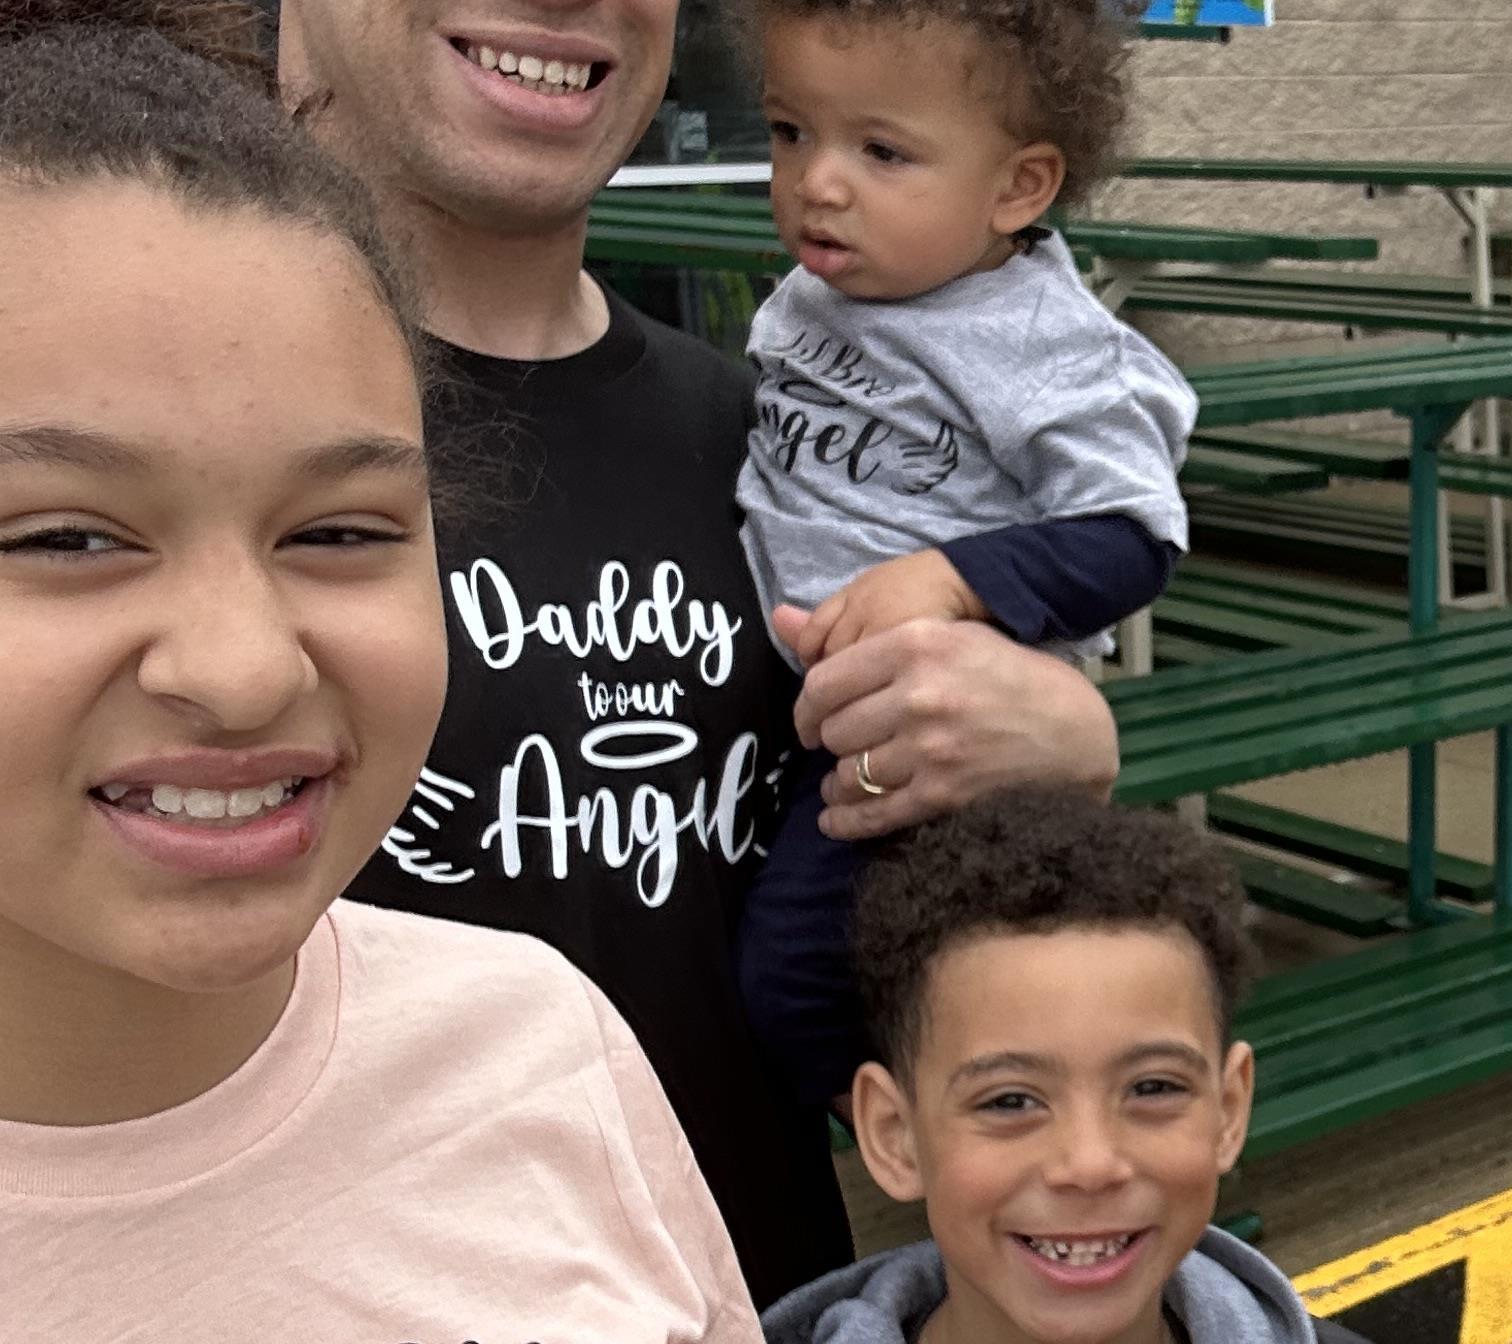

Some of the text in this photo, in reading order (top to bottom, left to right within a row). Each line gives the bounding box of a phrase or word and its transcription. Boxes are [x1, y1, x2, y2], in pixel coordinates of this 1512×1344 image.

[761, 404, 894, 484] ngel
[450, 558, 742, 686] Daddy
[577, 670, 685, 721] to our
